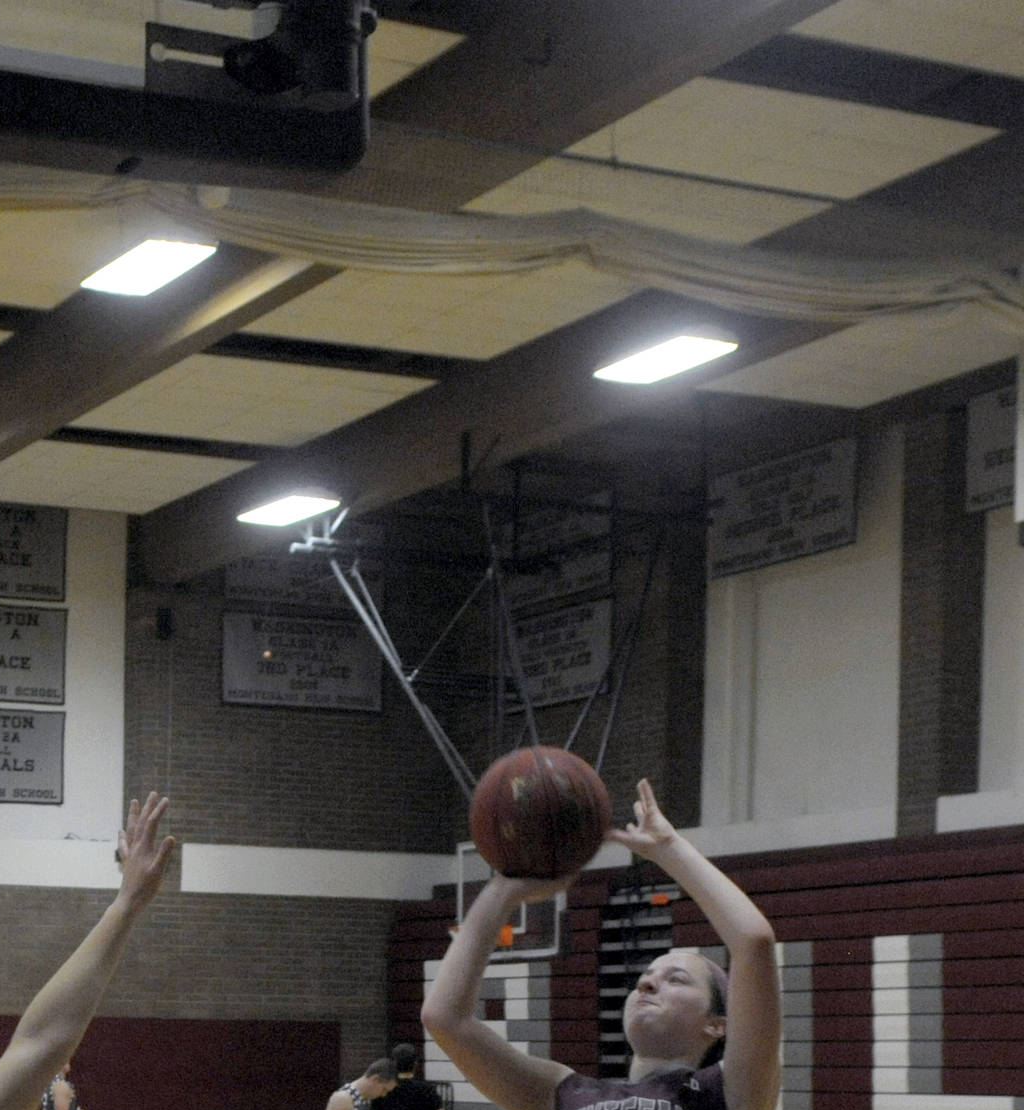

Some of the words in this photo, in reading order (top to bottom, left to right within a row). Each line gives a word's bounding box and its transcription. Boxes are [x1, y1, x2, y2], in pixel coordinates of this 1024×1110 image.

[9, 629, 21, 640] A
[15, 686, 61, 698] SCHOOL
[2, 731, 21, 743] 2A
[12, 788, 58, 799] SCHOOL
